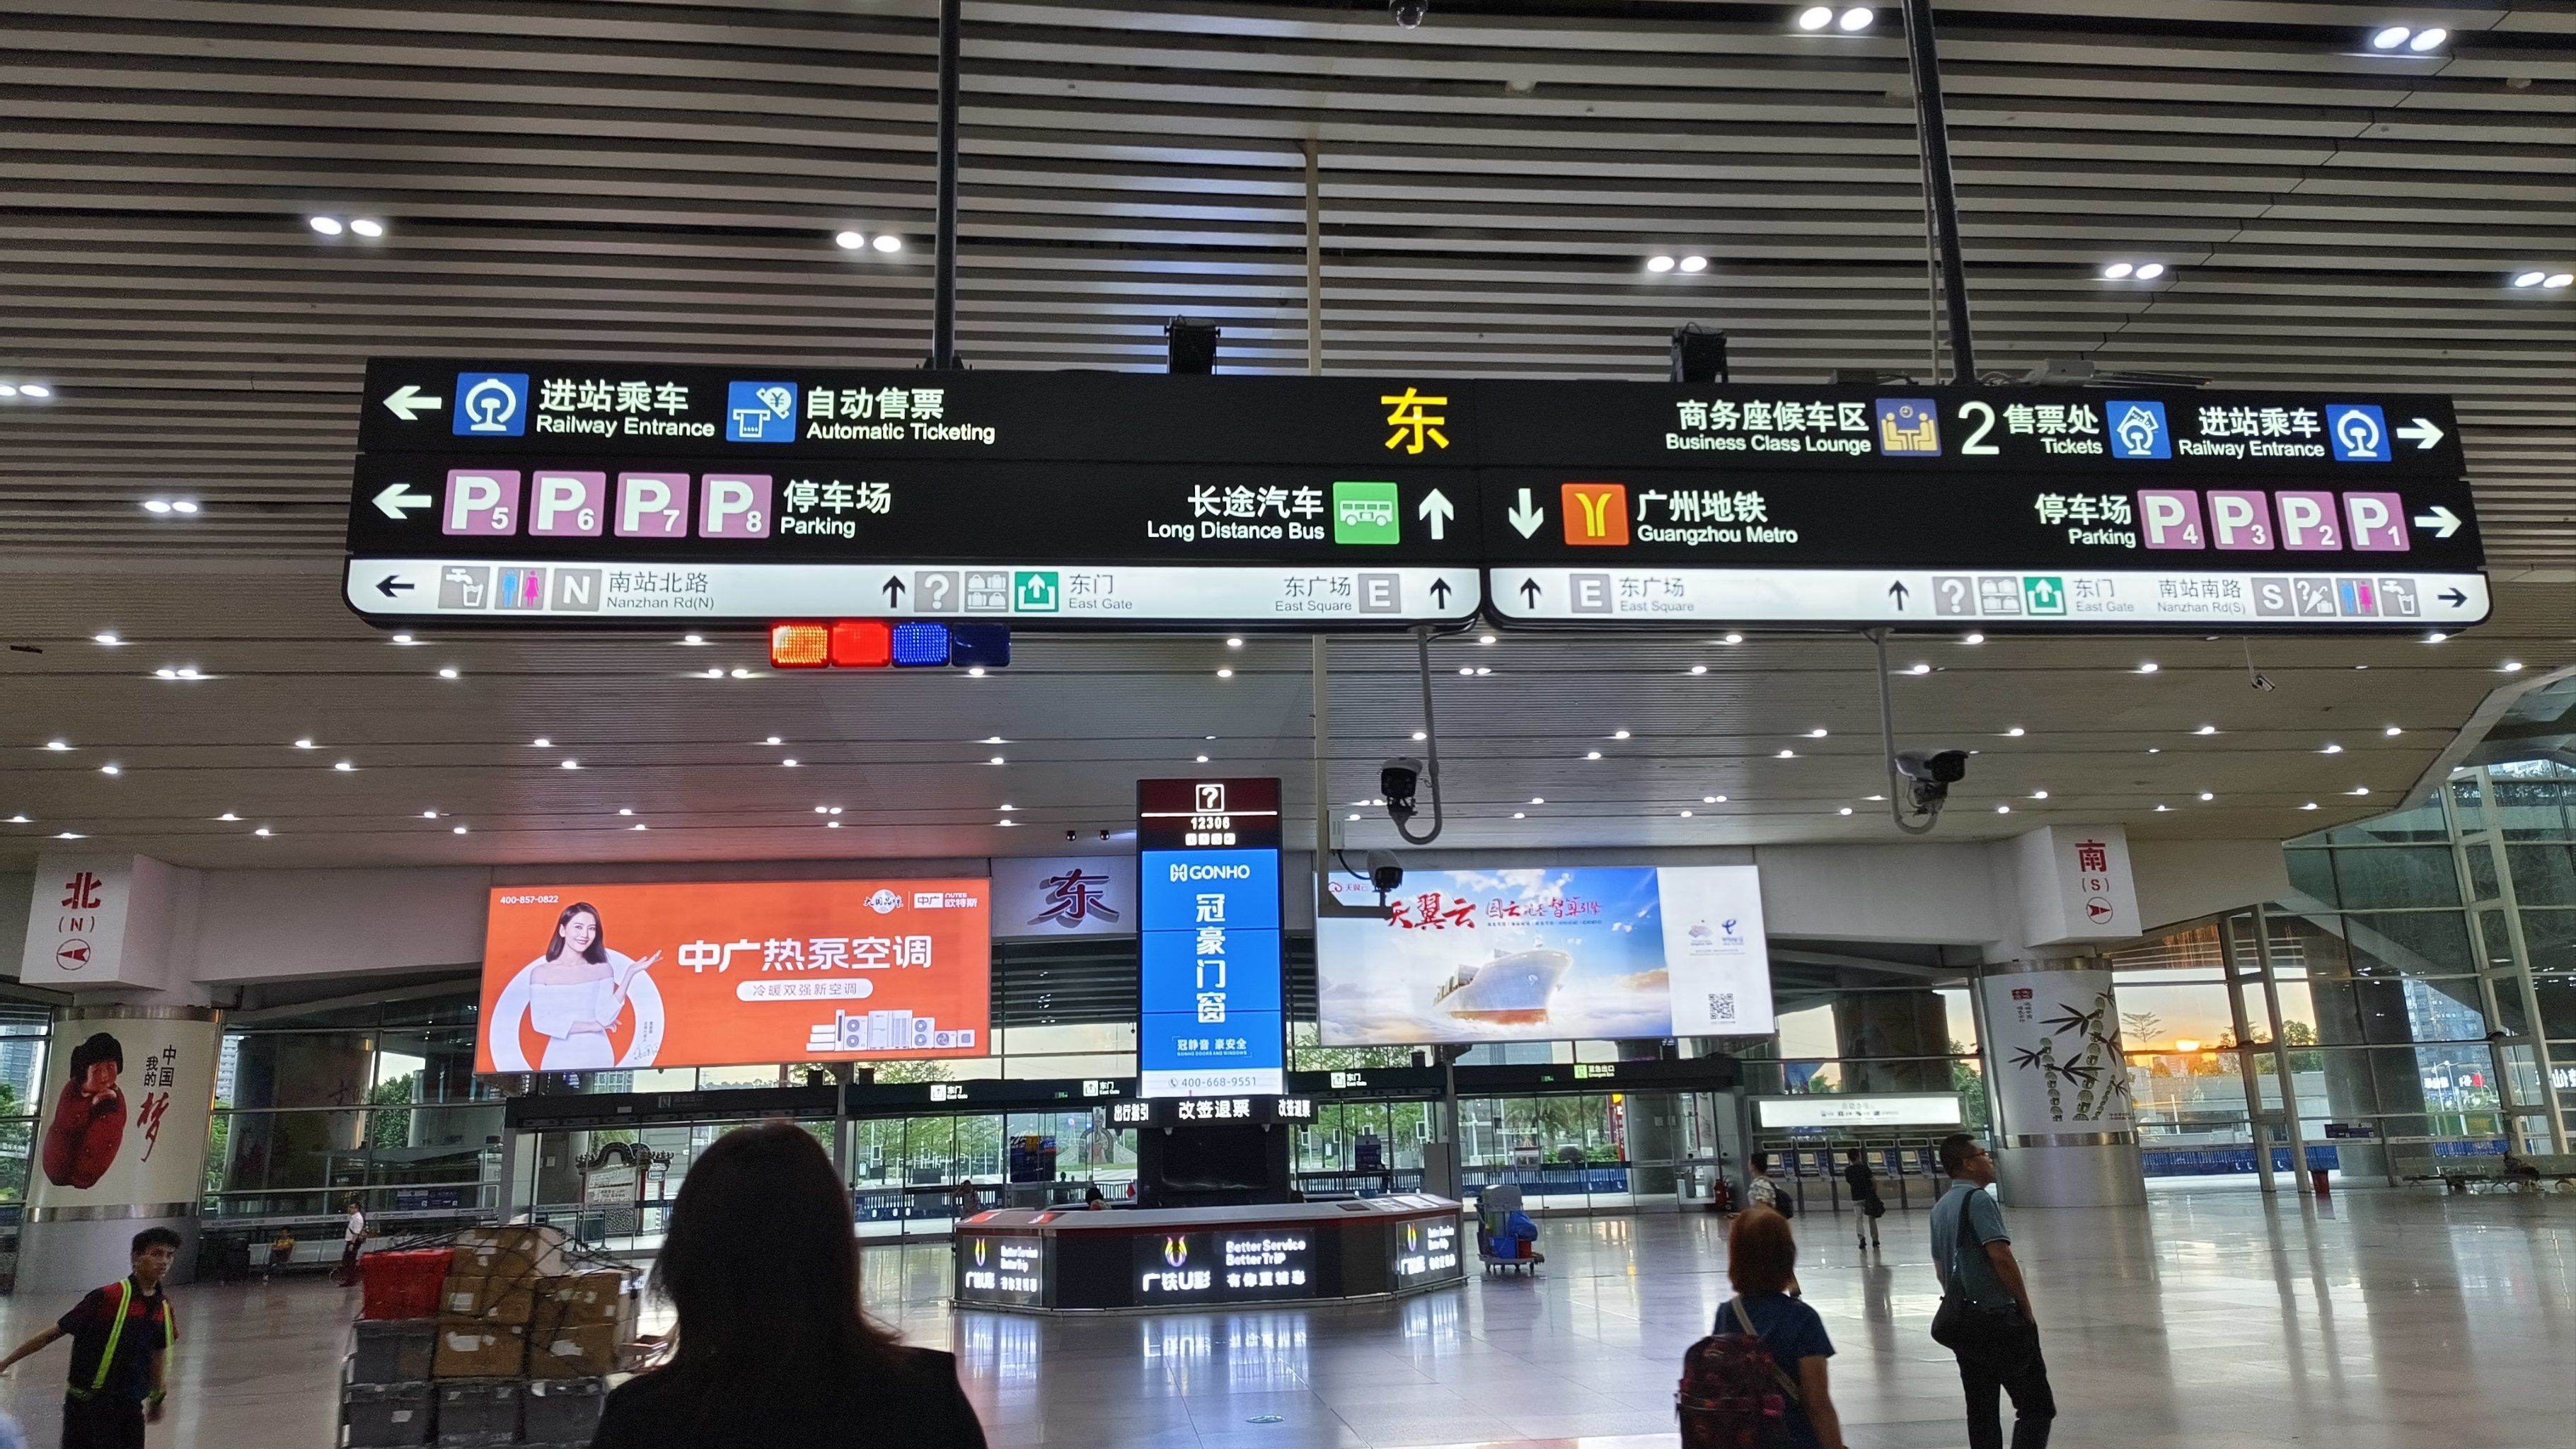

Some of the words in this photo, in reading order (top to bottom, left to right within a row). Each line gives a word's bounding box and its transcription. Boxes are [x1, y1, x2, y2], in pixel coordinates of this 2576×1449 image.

[540, 379, 689, 415] 进站乘车
[807, 386, 945, 420] 自动售票
[536, 415, 617, 437] Railway
[624, 417, 715, 437] Entrance
[1381, 387, 1449, 454] 东
[1676, 399, 1869, 432] 商务座候车区
[2003, 404, 2100, 434] 售票处
[2198, 407, 2321, 438] 进站乘车
[807, 422, 904, 441] Automatic
[911, 422, 995, 444] Ticketing
[1958, 401, 1999, 455] 2
[1665, 434, 1746, 451] Business
[1751, 435, 1801, 451] Class
[1806, 436, 1871, 455] Lounge
[2041, 438, 2103, 454] Tickets
[2179, 441, 2245, 459] Railway
[2251, 441, 2325, 457] Entrance
[451, 476, 509, 529] P5
[537, 477, 594, 530] P6
[623, 479, 680, 531] P7
[707, 481, 762, 532] P8
[784, 479, 891, 514] 停车场
[1187, 484, 1324, 519] 长途汽车
[1636, 490, 1768, 523] 广州地铁
[2035, 492, 2132, 525] 停车场
[780, 517, 855, 538] Parking
[2145, 495, 2197, 544] P4
[2214, 497, 2265, 545] P3
[2282, 497, 2335, 545] P2
[2350, 498, 2400, 545] P1
[1147, 521, 1195, 541] Long
[1201, 521, 1283, 539] Distance
[1288, 522, 1325, 540] Bus
[1637, 525, 1742, 545] Guangzhou
[1747, 526, 1798, 543] Metro
[2068, 528, 2136, 548] Parking
[563, 575, 590, 604] N
[609, 572, 709, 593] 南站北路
[1070, 575, 1114, 595] 东门
[1284, 576, 1351, 597] 东广场
[1369, 579, 1391, 606] E
[1580, 580, 1602, 606] E
[1619, 578, 1685, 597] 东广场
[2073, 578, 2115, 599] 东门
[2159, 579, 2241, 599] 南站南路
[607, 596, 669, 608] Nanzhan
[674, 596, 715, 611] Rd(N)
[1069, 598, 1097, 609] East
[1102, 599, 1132, 610] Gate
[2077, 601, 2103, 612] East
[2106, 601, 2135, 612] Gate
[2263, 584, 2284, 608] S
[1276, 601, 1303, 612] East
[1307, 601, 1351, 613] Square
[1620, 601, 1647, 611] East
[1651, 601, 1694, 613] Square
[2157, 602, 2209, 613] Nanzhan
[2213, 601, 2246, 615] Rd(S)
[1191, 816, 1230, 830] 12306
[2074, 839, 2107, 872] 南
[1189, 864, 1249, 880] GONHO
[61, 872, 103, 909] 北
[500, 895, 559, 904] 400-857-0822
[918, 896, 940, 905] 中广
[1039, 869, 1119, 920] 东
[945, 898, 978, 908] 欧特斯
[1388, 893, 1477, 930] 天翼云
[678, 935, 931, 973] 中广热泵空调
[1196, 894, 1226, 1023] 冠豪门窗
[753, 983, 857, 997] 冷暖双强新空调
[144, 1056, 158, 1087] 我的
[158, 1044, 176, 1087] 中国
[1182, 1077, 1256, 1087] 400-668-9551
[1179, 1099, 1249, 1120] 改签退票
[1278, 1099, 1310, 1117] 改签退票
[1225, 1241, 1262, 1253] Better
[1263, 1238, 1306, 1252] Service
[1225, 1253, 1261, 1266] Better
